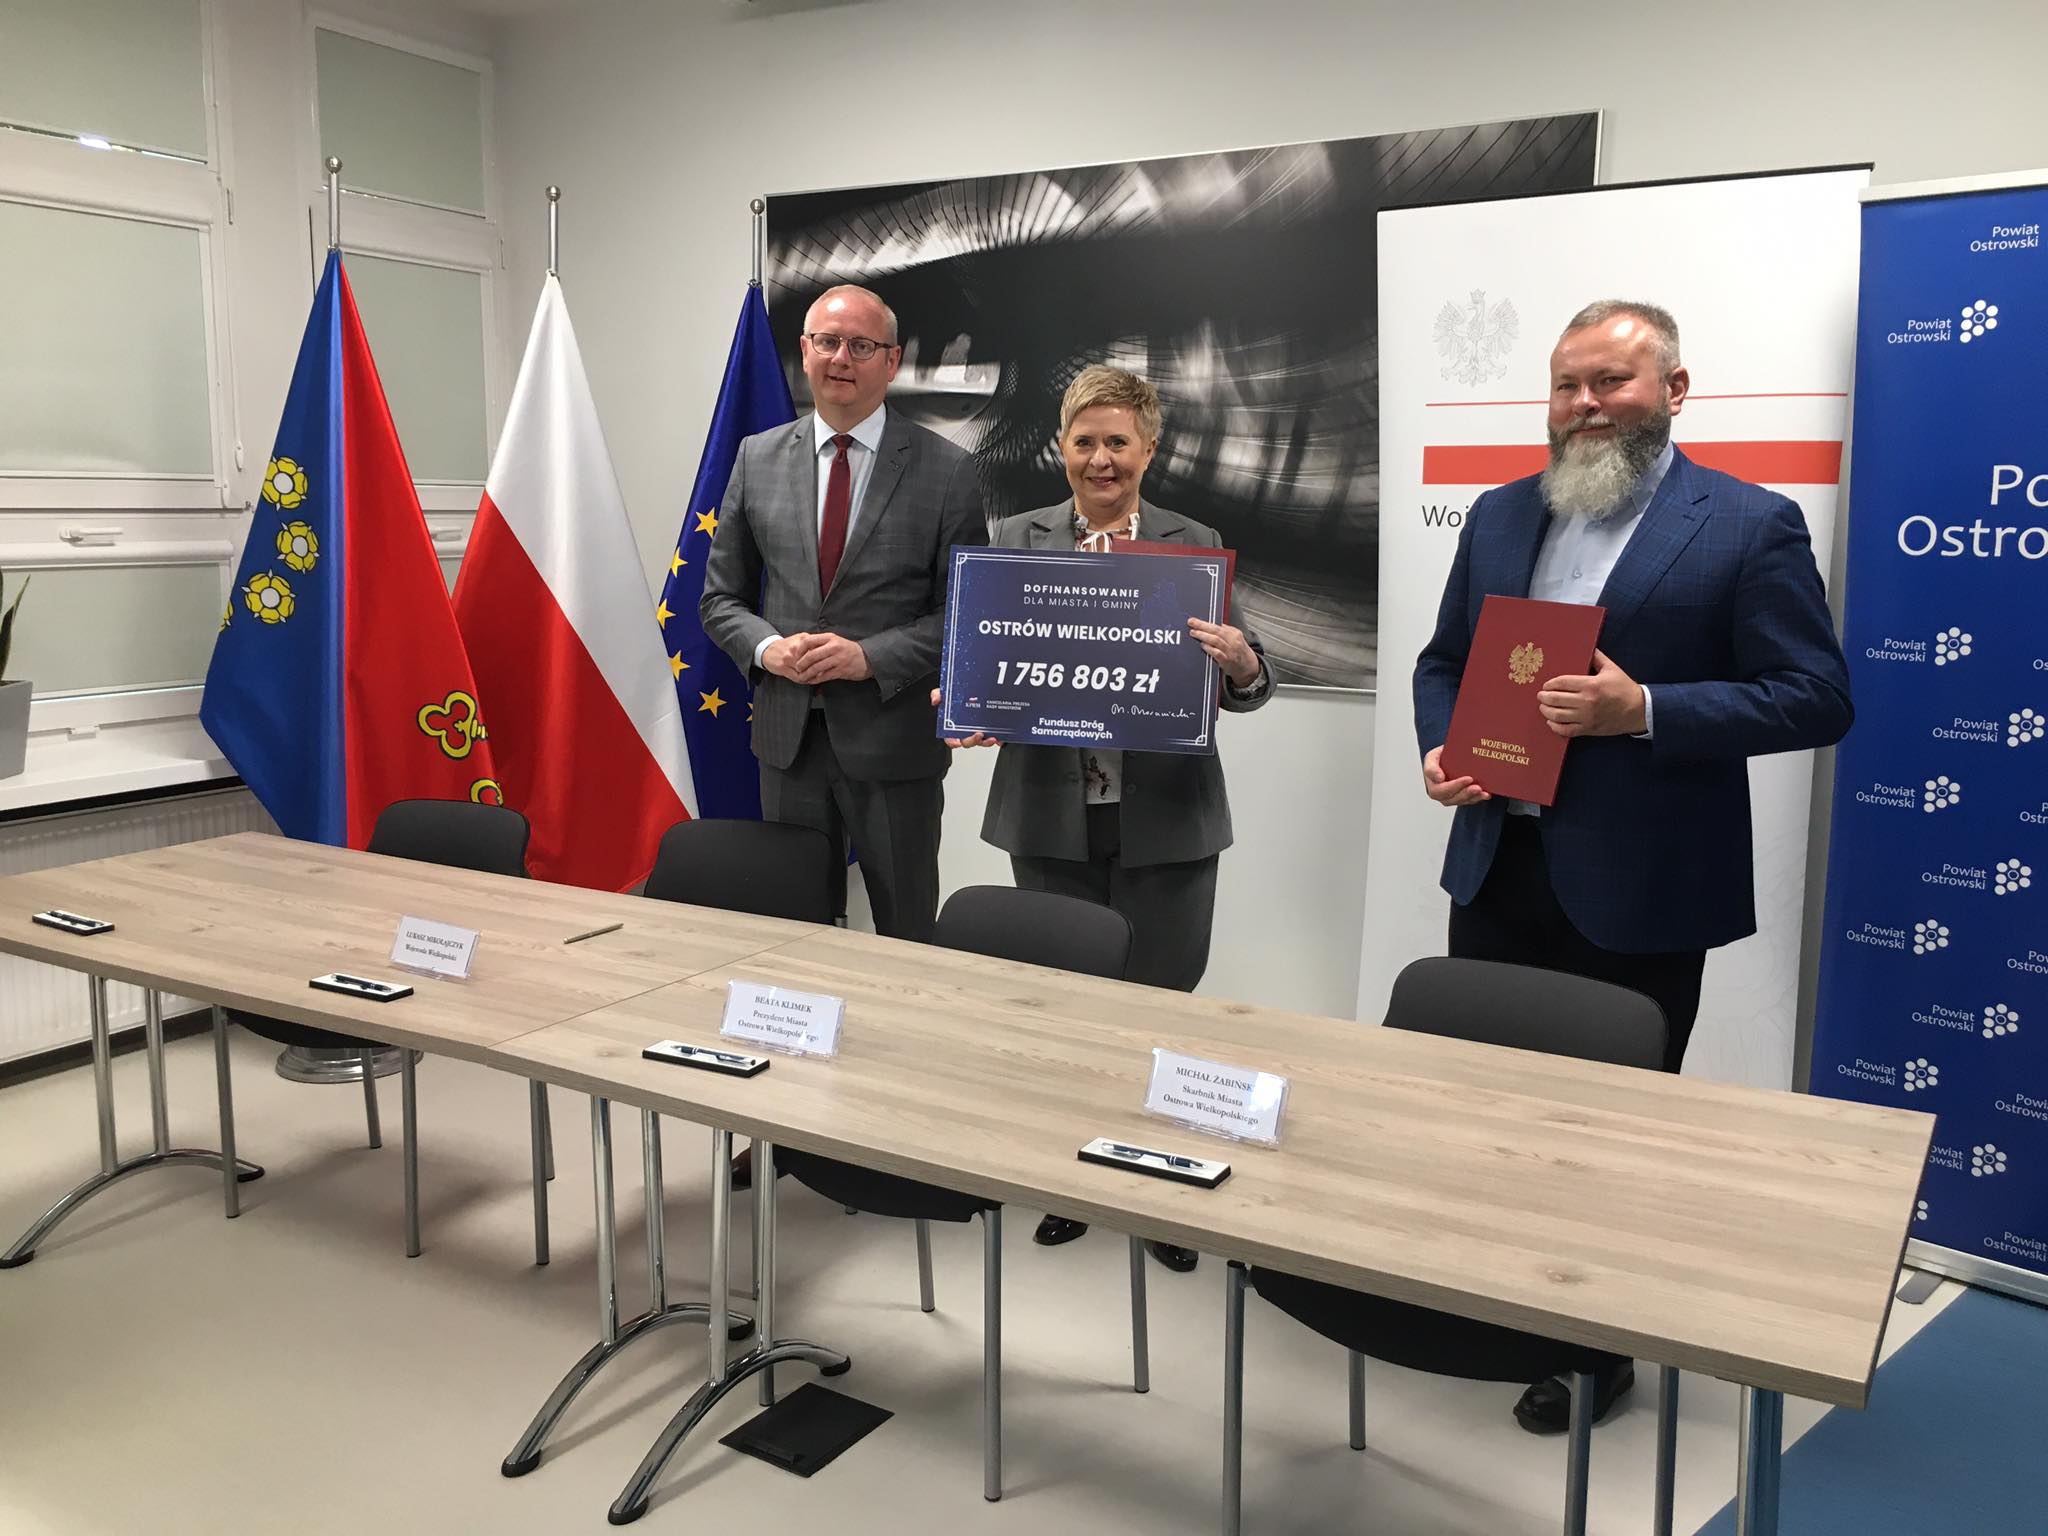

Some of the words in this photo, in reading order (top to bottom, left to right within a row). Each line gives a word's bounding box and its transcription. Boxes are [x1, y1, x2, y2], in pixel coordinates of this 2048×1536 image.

[1992, 223, 2039, 238] Powiat
[1970, 235, 2039, 252] Ostrowski
[1907, 318, 1952, 332] Powiat
[1887, 329, 1951, 344] Ostrowski
[1422, 505, 1469, 527] Wo
[1897, 514, 2048, 560] Ostro
[1023, 583, 1140, 598] DOFINANSOWANIE
[1023, 596, 1044, 605] DLA
[1048, 597, 1089, 608] MIASTA
[1101, 600, 1139, 610] GMINY
[978, 618, 1053, 638] OSTRÓW
[1057, 623, 1182, 645] WIELKOPOLSKI
[1884, 638, 1926, 651] Powiat
[1866, 647, 1926, 662] Ostrowski
[996, 661, 1008, 685] 1
[1013, 662, 1065, 687] 756
[1071, 665, 1127, 692] 803
[1133, 668, 1161, 694] zł
[1039, 717, 1079, 729] Fundusz
[1080, 719, 1104, 732] Dróg
[1953, 717, 1999, 731] Powiat
[1031, 726, 1113, 740] Samorządowych
[1932, 727, 1998, 743] Ostrowski
[1480, 738, 1526, 754] WOJEWODA
[1472, 747, 1530, 765] WIELKOPOLSKI
[1873, 783, 1915, 798] Powiat
[1856, 791, 1915, 808] Ostrowski
[1942, 863, 1986, 879] Powiat
[1921, 872, 1986, 890] Ostrowski
[1846, 930, 1905, 950] Ostrowski
[1864, 923, 1906, 940] Powiat
[754, 995, 780, 1008] BEATA
[781, 1000, 813, 1014] KLIMEK
[1931, 1004, 1975, 1022] Powiat
[738, 1019, 765, 1031] Ostrowa
[753, 1009, 785, 1023] Prezydent
[786, 1015, 808, 1027] Miasta
[1911, 1011, 1974, 1032] Ostrowski
[1175, 1066, 1212, 1083] MICHAŁ
[1837, 1064, 1896, 1086] Ostrowski
[1855, 1058, 1897, 1076] Powiat
[1163, 1093, 1194, 1108] Ostrowa
[1182, 1084, 1215, 1100] Skarbnik
[1217, 1093, 1243, 1107] Miasta
[2016, 1093, 2048, 1110] Powi
[1931, 1145, 1964, 1160] owiat
[1928, 1155, 1963, 1170] owski
[1983, 1236, 2047, 1262] Ostrowski
[2003, 1231, 2048, 1251] Powiat
